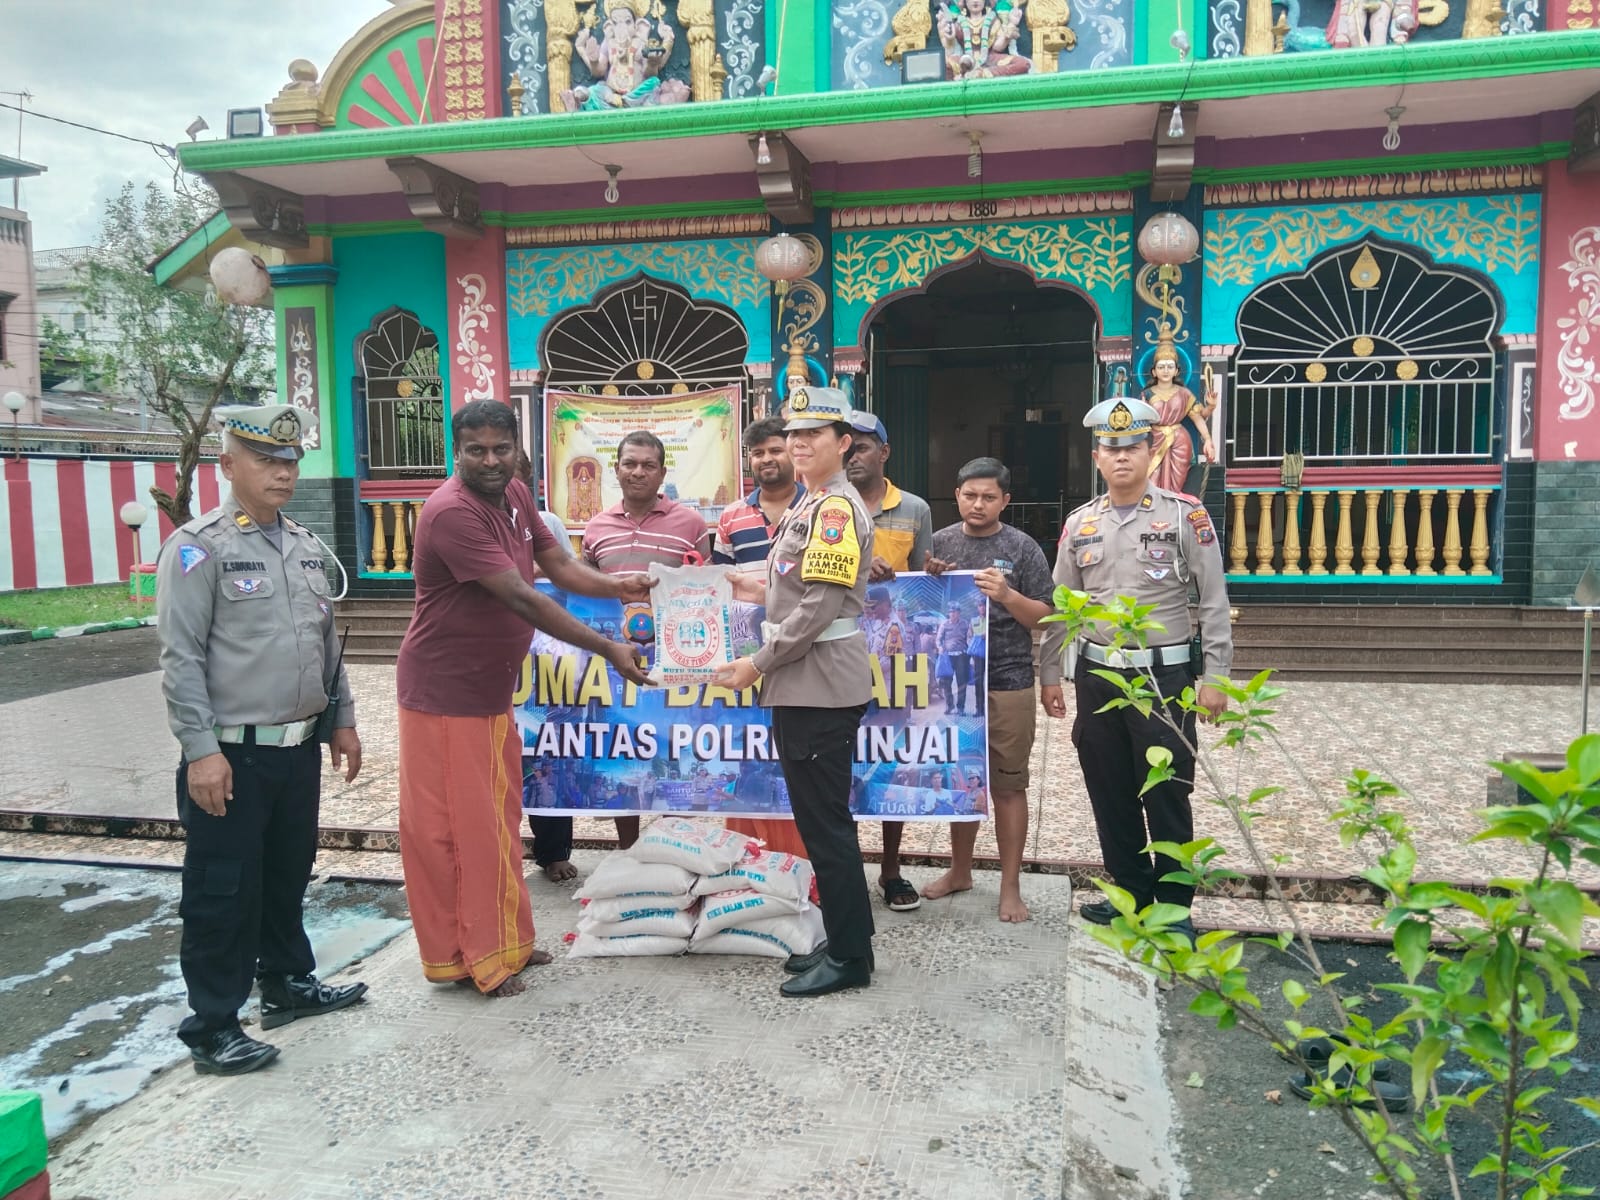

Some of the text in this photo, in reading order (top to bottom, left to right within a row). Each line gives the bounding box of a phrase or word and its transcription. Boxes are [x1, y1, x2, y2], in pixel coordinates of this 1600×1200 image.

[968, 201, 997, 217] 1880
[1140, 532, 1177, 543] POLRI
[807, 552, 854, 565] KASATGAS
[809, 560, 848, 573] KAMSEL
